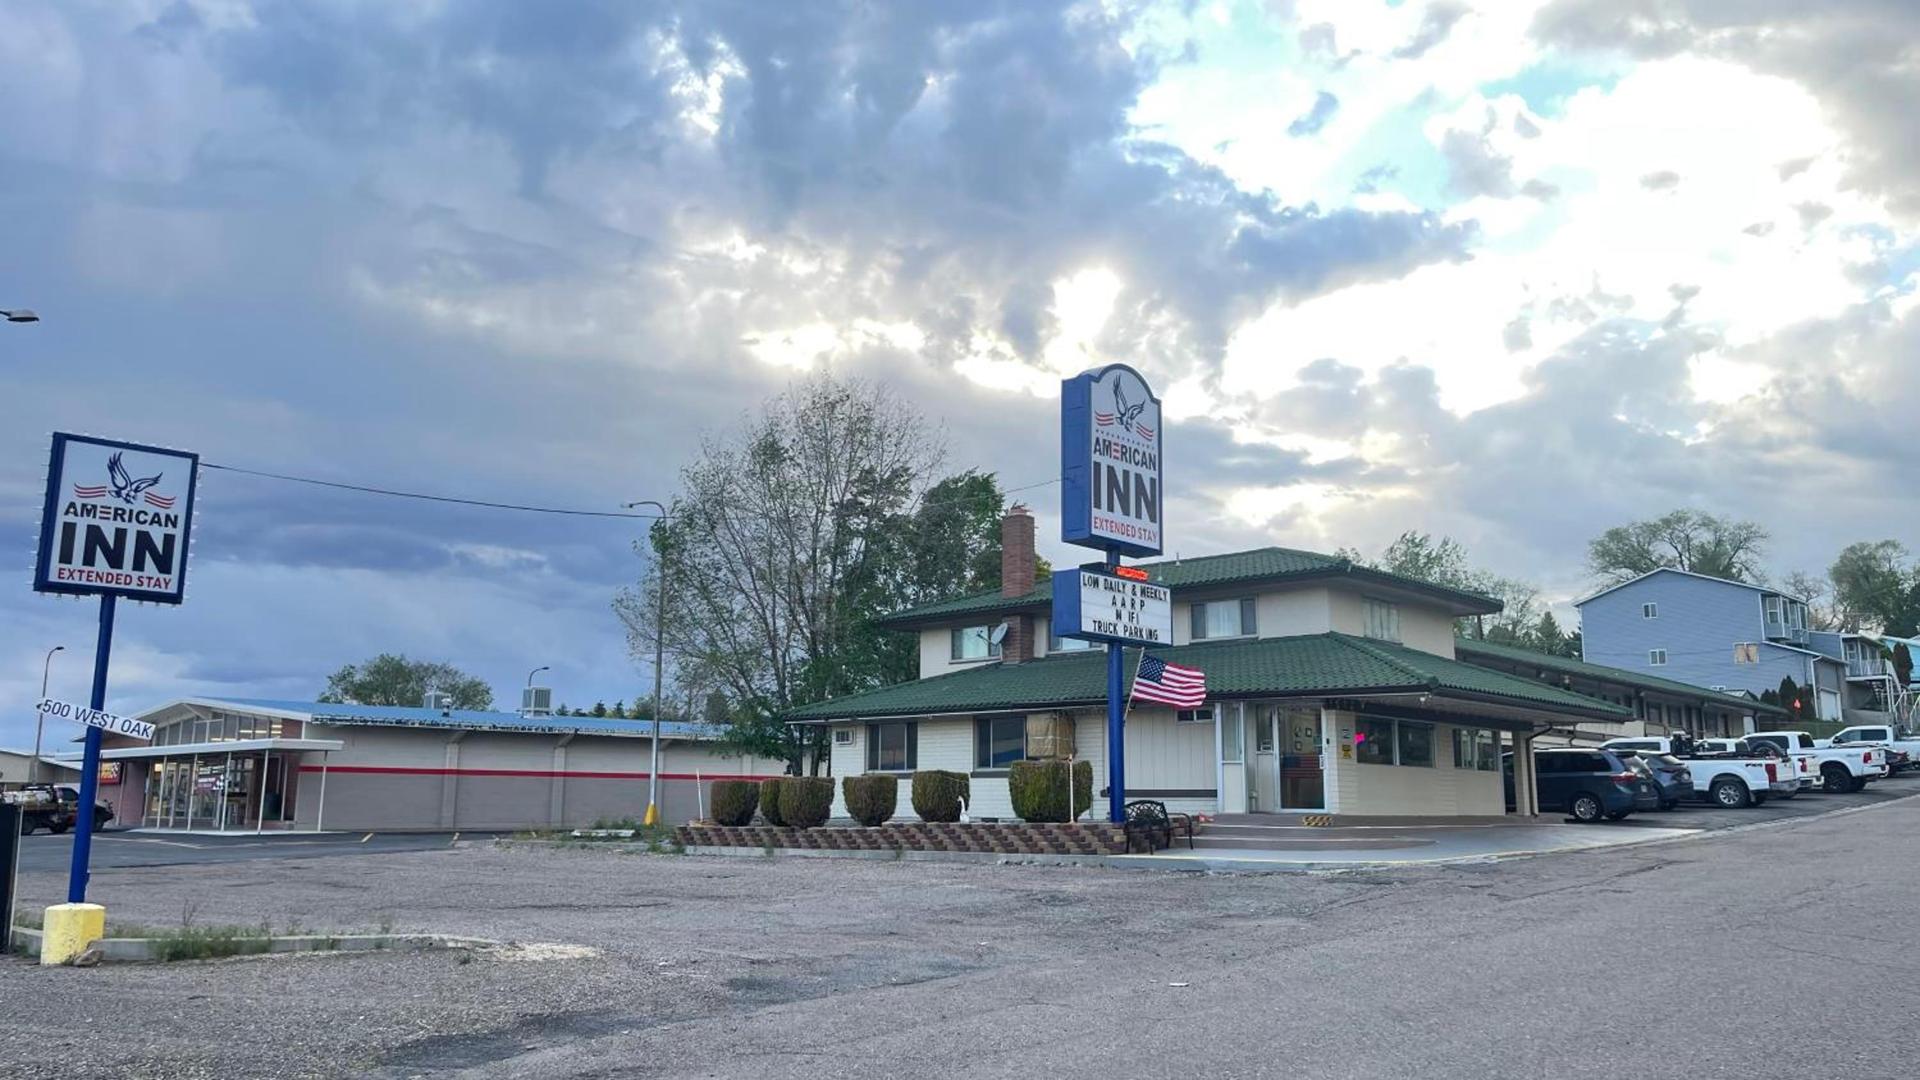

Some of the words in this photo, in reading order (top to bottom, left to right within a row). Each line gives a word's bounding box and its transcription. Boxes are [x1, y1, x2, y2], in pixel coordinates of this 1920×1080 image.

[1093, 437, 1157, 472] AMERICAN
[1093, 461, 1157, 524] INN
[63, 501, 178, 529] AMERICAN
[1093, 516, 1136, 538] EXTENDED
[1137, 525, 1157, 543] STAY
[58, 521, 176, 575] INN
[57, 567, 133, 586] EXTENDED
[136, 575, 172, 590] STAY
[1082, 574, 1099, 589] LOW
[1104, 578, 1127, 594] DAILY
[1131, 584, 1138, 596] &
[1140, 585, 1168, 601] WEEKLY
[1092, 620, 1118, 636] TRUCK
[1123, 624, 1159, 641] PARKING
[42, 699, 71, 718] 500
[74, 706, 118, 729] WEST
[120, 719, 153, 738] OAK
